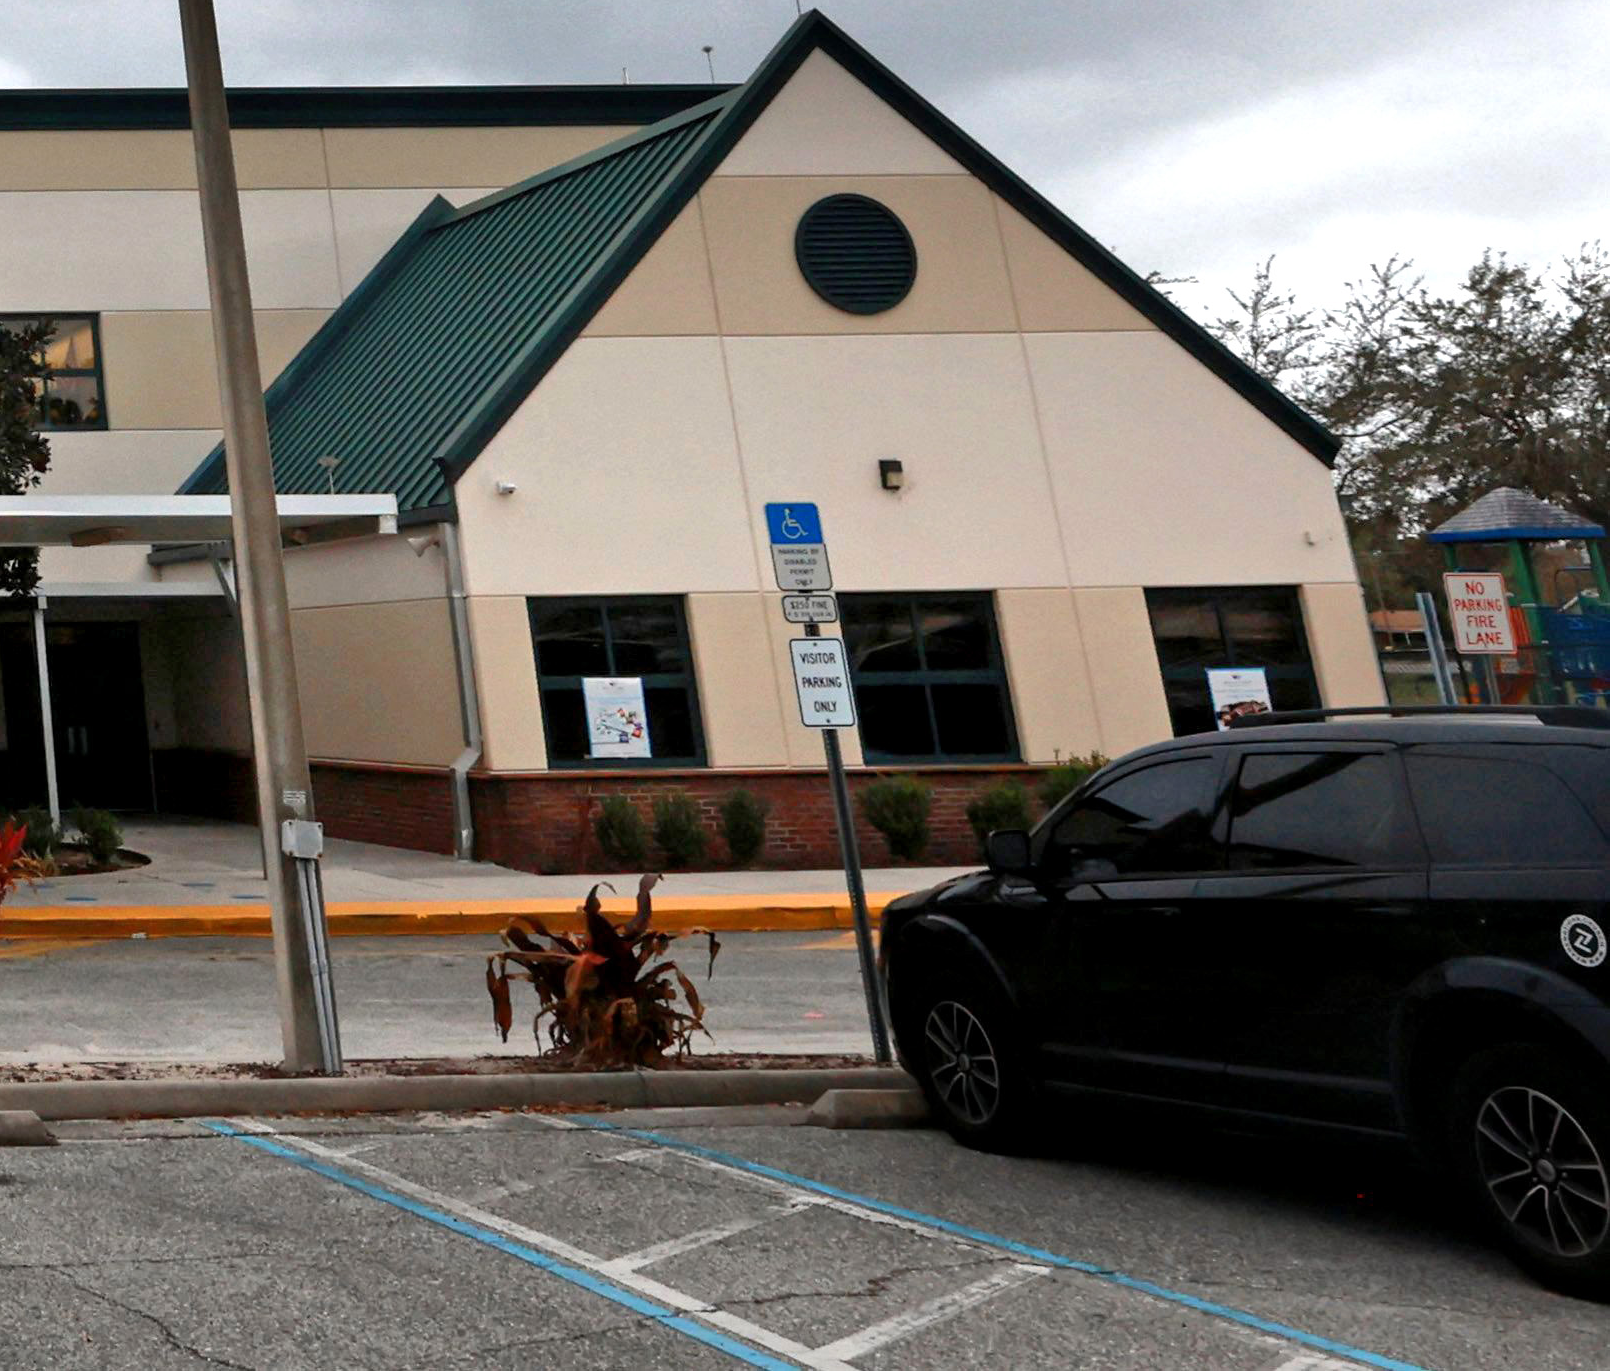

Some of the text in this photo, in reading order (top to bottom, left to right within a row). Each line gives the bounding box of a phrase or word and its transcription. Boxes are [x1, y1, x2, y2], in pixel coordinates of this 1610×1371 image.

[1465, 581, 1485, 595] NO
[790, 601, 828, 610] $250 FINE
[1453, 598, 1503, 612] PARKING
[1467, 615, 1497, 628] FIRE
[1466, 631, 1504, 646] LANE
[799, 652, 836, 664] VISITOR
[802, 676, 843, 688] PARKING
[814, 701, 838, 713] ONLY
